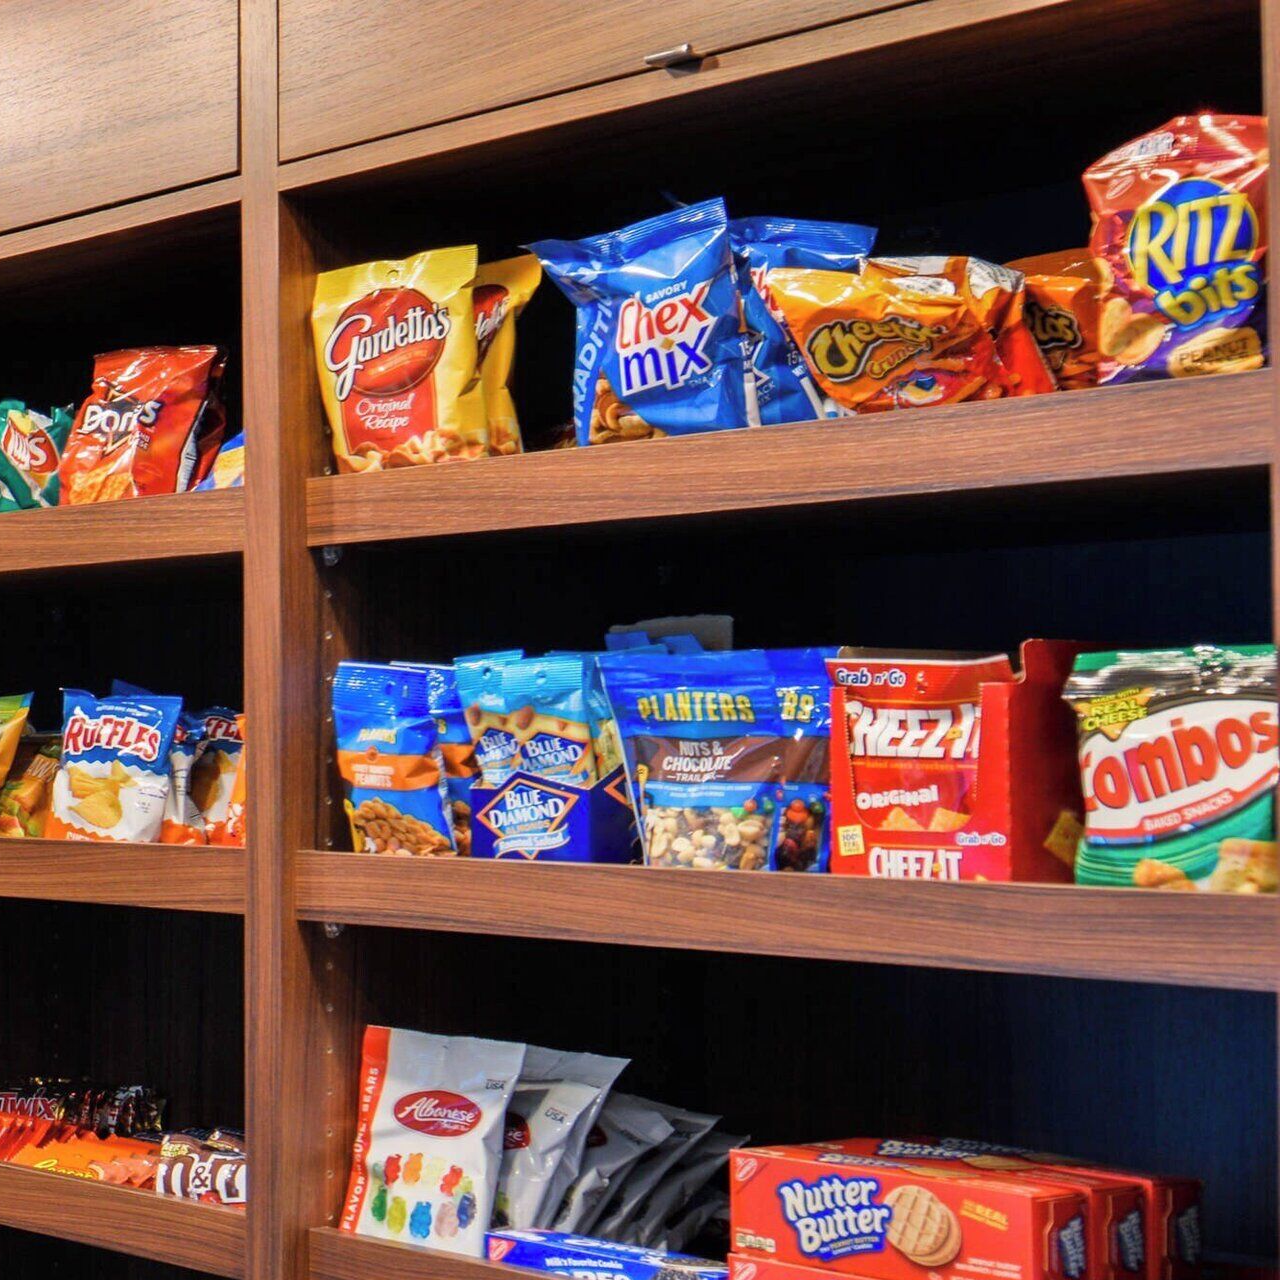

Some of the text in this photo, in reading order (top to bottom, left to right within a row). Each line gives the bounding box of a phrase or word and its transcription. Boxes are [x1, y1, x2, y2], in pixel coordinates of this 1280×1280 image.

[1129, 192, 1249, 297] RITZ
[645, 280, 688, 305] SAVORY
[1153, 261, 1259, 329] bits
[615, 281, 711, 351] Chex
[324, 301, 451, 402] Gardetto's
[623, 326, 712, 390] mix
[355, 395, 413, 418] Original
[363, 412, 410, 430] Recipe
[836, 669, 869, 687] Grab
[888, 671, 906, 687] Go
[637, 690, 756, 723] PLANTERS
[1089, 699, 1140, 717] REAL
[1083, 707, 1148, 732] CHEESE
[64, 715, 160, 761] RUFFLES
[480, 733, 508, 751] BLUE
[527, 739, 564, 757] BLUE
[678, 740, 723, 757] NUTS &
[662, 754, 734, 773] CHOCOLATE
[675, 772, 702, 783] TRAIL
[505, 790, 541, 810] BLUE
[1144, 791, 1235, 832] BAKED SNACKS
[490, 798, 565, 828] DIAMOND
[363, 1067, 379, 1113] BEARS
[485, 1079, 505, 1091] USA
[397, 1097, 477, 1121] Albanese
[544, 1110, 564, 1124] USA
[780, 1177, 877, 1222] Nutter
[795, 1206, 890, 1253] Butter
[545, 1258, 624, 1270] Milk's Favorite Cookie
